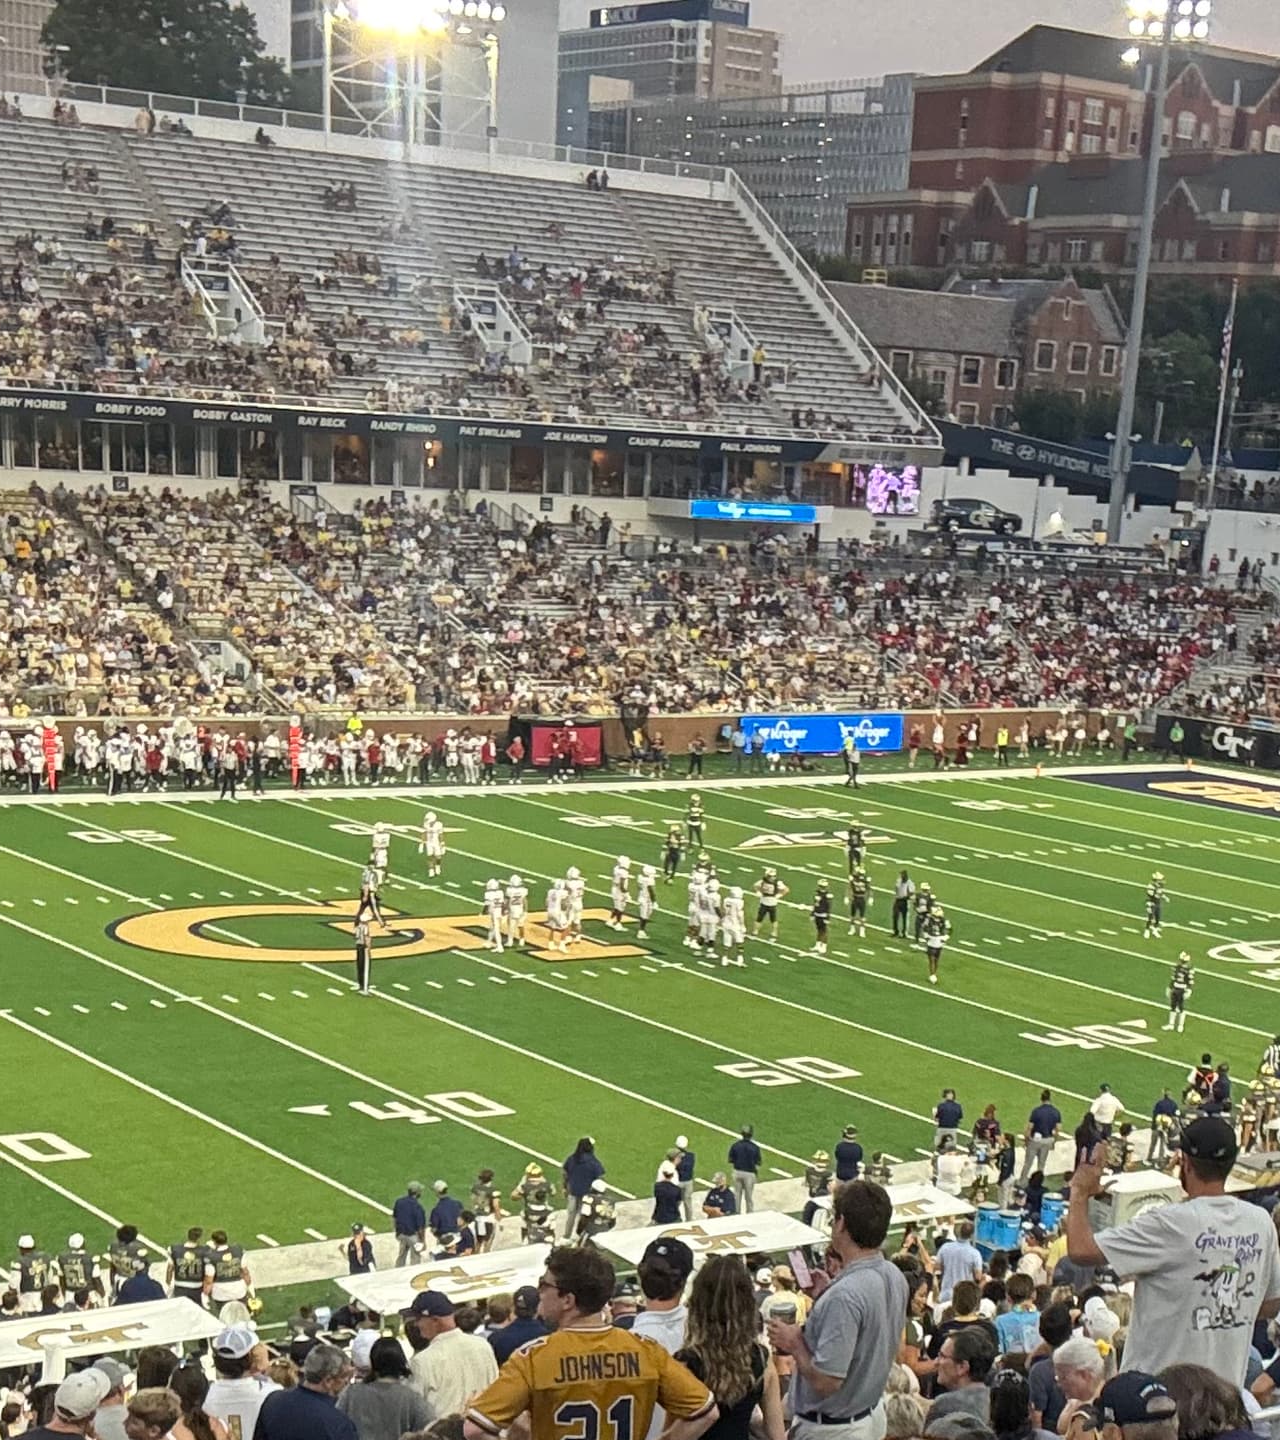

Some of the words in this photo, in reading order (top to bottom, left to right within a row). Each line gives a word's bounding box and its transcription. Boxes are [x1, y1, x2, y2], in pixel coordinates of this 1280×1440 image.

[23, 397, 68, 411] MORRIS
[95, 403, 132, 415] BOBBY
[134, 405, 167, 417] DODD
[193, 409, 228, 422] BOBBY
[231, 410, 273, 424] GASTON
[298, 415, 318, 427] RAY
[319, 417, 347, 428] BECK
[991, 438, 1015, 455] THE
[1036, 450, 1091, 474] HYUNDAI
[770, 720, 809, 750] Kroger
[851, 718, 891, 748] Kroger
[105, 898, 665, 963] GT
[714, 1056, 863, 1087] 50
[347, 1090, 517, 1125] 40
[1194, 1232, 1260, 1253] GRAVEYARD
[553, 1352, 641, 1384] JOHNSON
